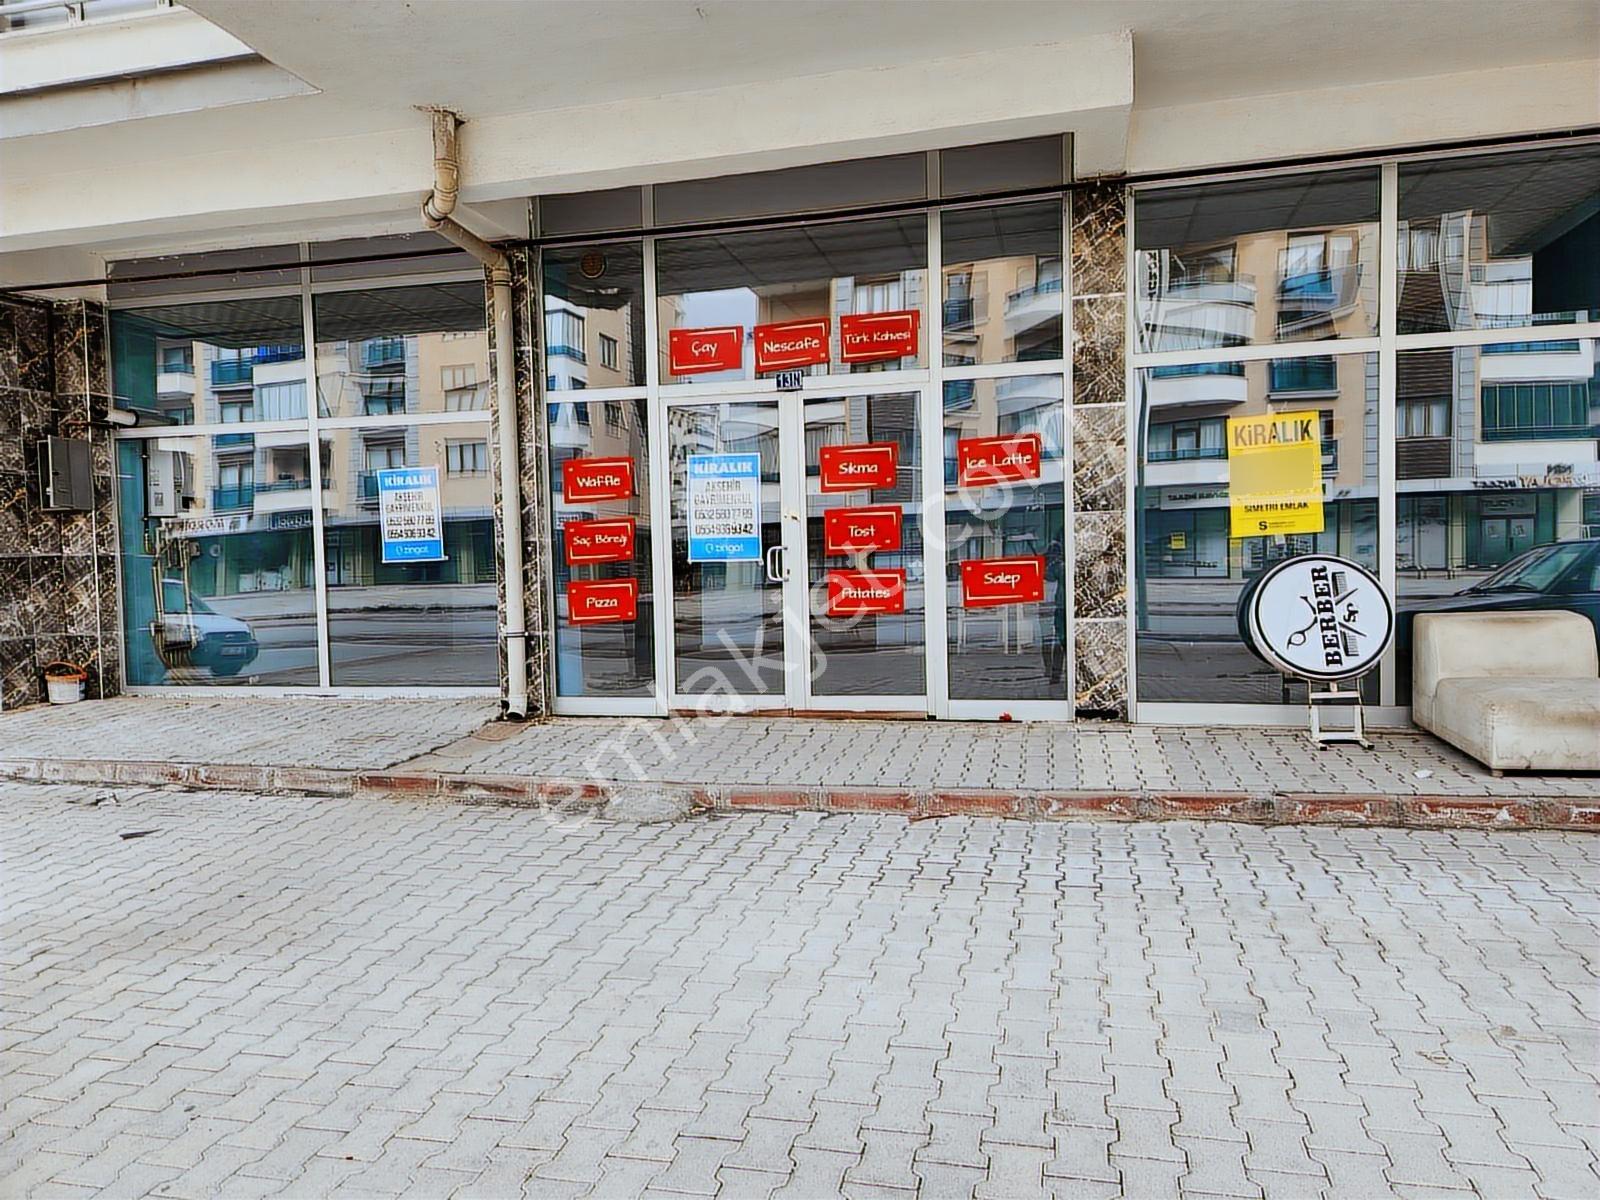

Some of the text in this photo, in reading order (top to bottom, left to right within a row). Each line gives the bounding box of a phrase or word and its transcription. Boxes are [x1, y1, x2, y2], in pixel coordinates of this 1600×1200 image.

[763, 339, 820, 353] Nescafe
[845, 333, 870, 345] Türk
[691, 340, 718, 357] Çay
[966, 453, 1033, 469] Ice Latte
[576, 475, 621, 488] Waffle
[848, 525, 876, 538] Tost
[984, 573, 1021, 589] Salep
[841, 587, 892, 600] Patates
[1311, 565, 1343, 667] BERBER
